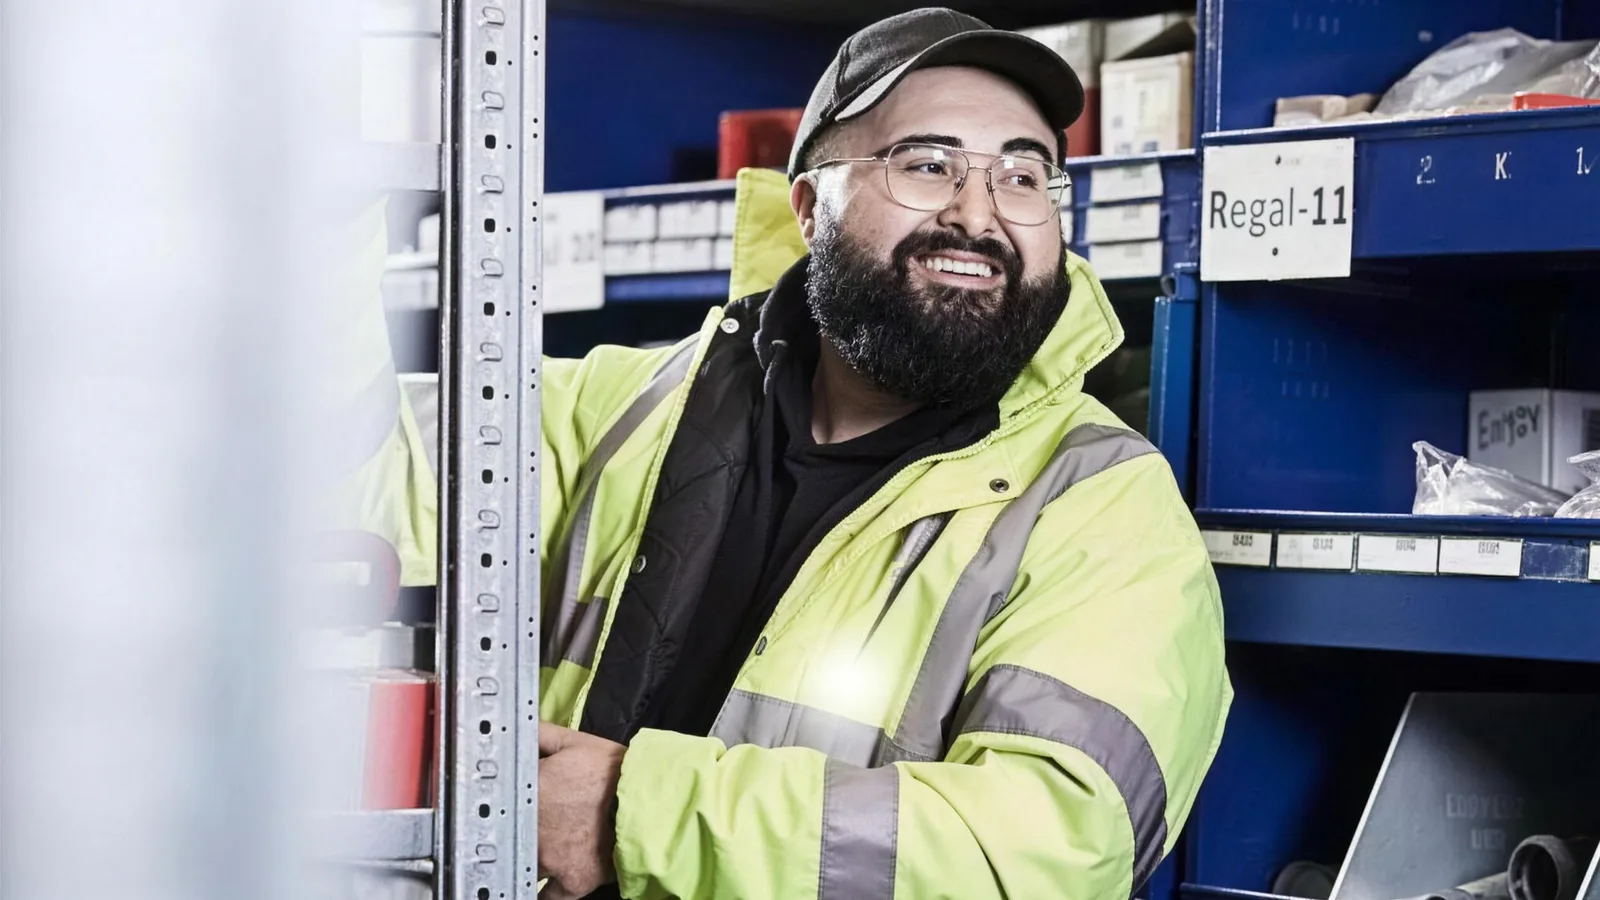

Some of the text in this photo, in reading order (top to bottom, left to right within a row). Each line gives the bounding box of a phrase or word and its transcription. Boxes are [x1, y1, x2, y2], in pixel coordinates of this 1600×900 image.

[1494, 150, 1509, 181] K
[1209, 186, 1348, 237] Regal-11
[1477, 403, 1541, 451] Enjoy
